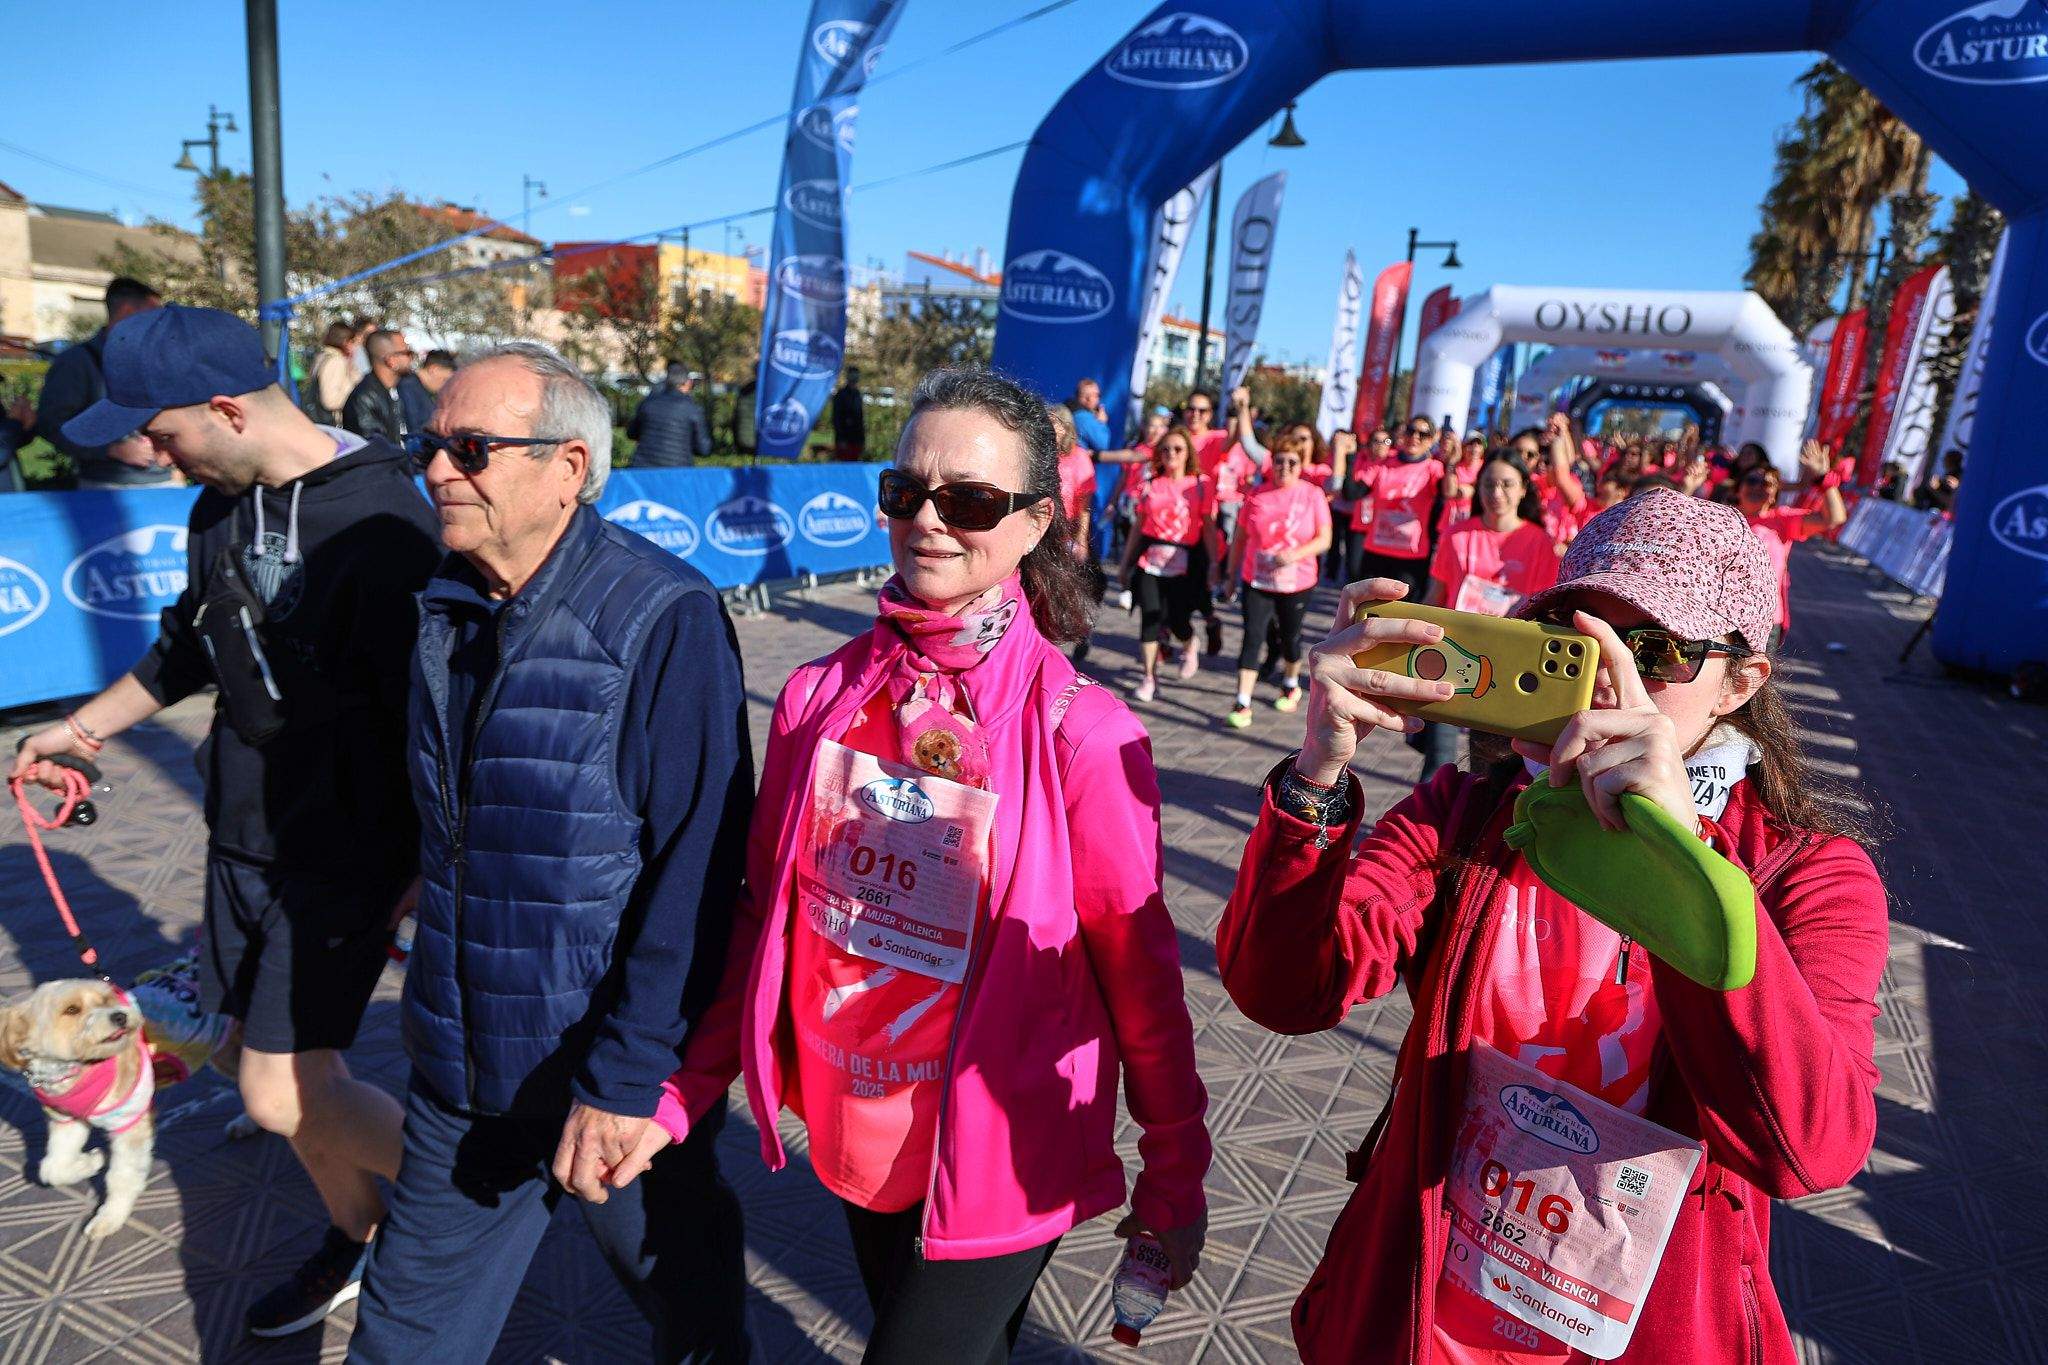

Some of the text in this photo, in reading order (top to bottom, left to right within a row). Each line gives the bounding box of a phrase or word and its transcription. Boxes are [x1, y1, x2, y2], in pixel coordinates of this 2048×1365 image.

[1112, 46, 1234, 71] ASTURIANA
[1535, 301, 1692, 337] OYSHO
[1710, 766, 1725, 780] TO
[865, 789, 928, 819] ASTURIANA
[850, 845, 918, 892] 016
[856, 886, 892, 907] 2661
[808, 902, 848, 936] OYSHO
[865, 908, 896, 926] MUJER
[902, 920, 943, 941] VALENCIA
[884, 939, 943, 967] Santander
[851, 1053, 872, 1077] DE
[877, 1060, 901, 1082] LA
[907, 1059, 943, 1082] MU
[852, 1078, 885, 1099] 2025
[1505, 1091, 1589, 1151] ASTURIANA
[1479, 1158, 1574, 1234] 016
[1481, 1208, 1527, 1247] 2662
[1461, 1217, 1474, 1232] DE
[1475, 1230, 1488, 1247] LA
[1489, 1240, 1530, 1272] MUJER
[1541, 1268, 1600, 1306] VALENCIA
[1512, 1285, 1595, 1337] Santander
[1493, 1314, 1540, 1349] 2025
